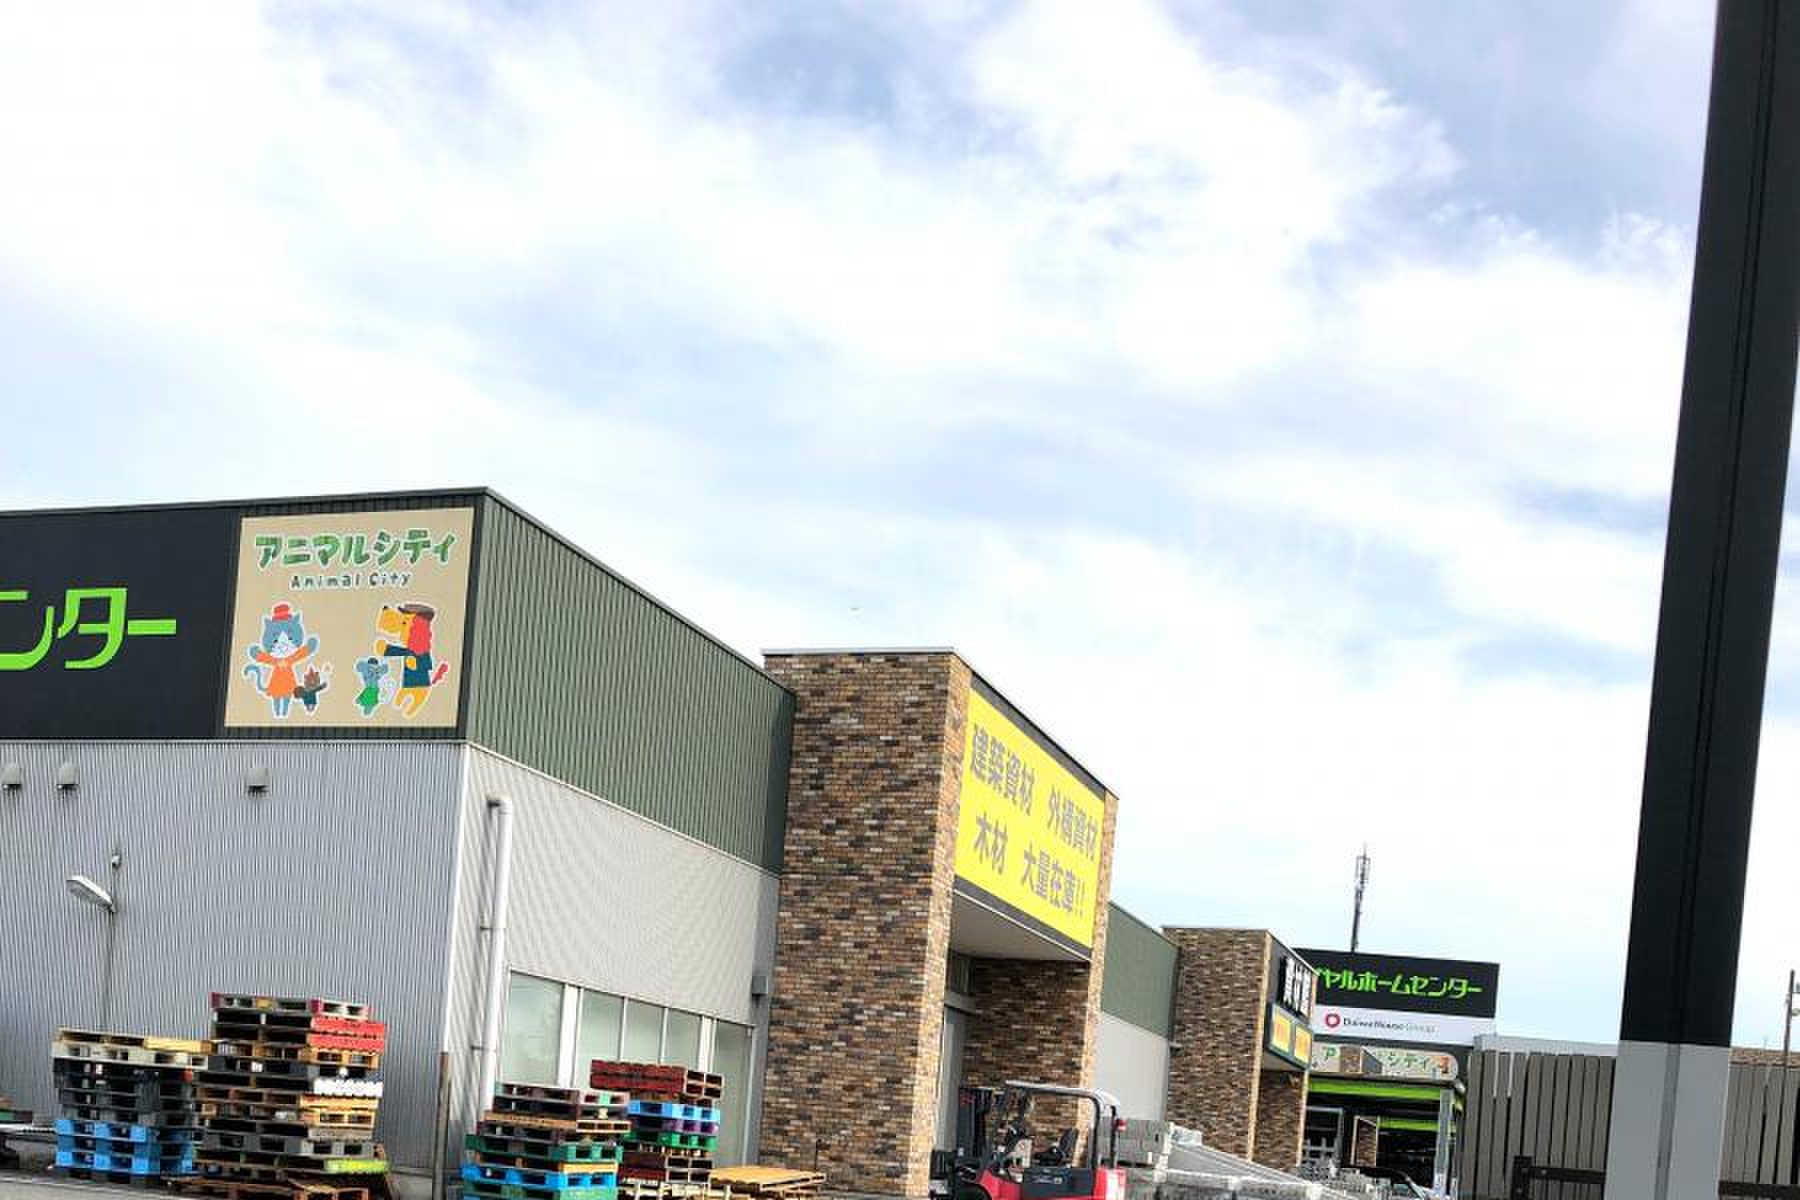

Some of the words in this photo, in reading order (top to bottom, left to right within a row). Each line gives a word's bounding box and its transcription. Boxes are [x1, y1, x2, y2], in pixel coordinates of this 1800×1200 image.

[255, 529, 456, 569] アニマルシティ
[290, 573, 361, 589] Animal
[368, 571, 412, 587] City
[974, 809, 1009, 875] 木材
